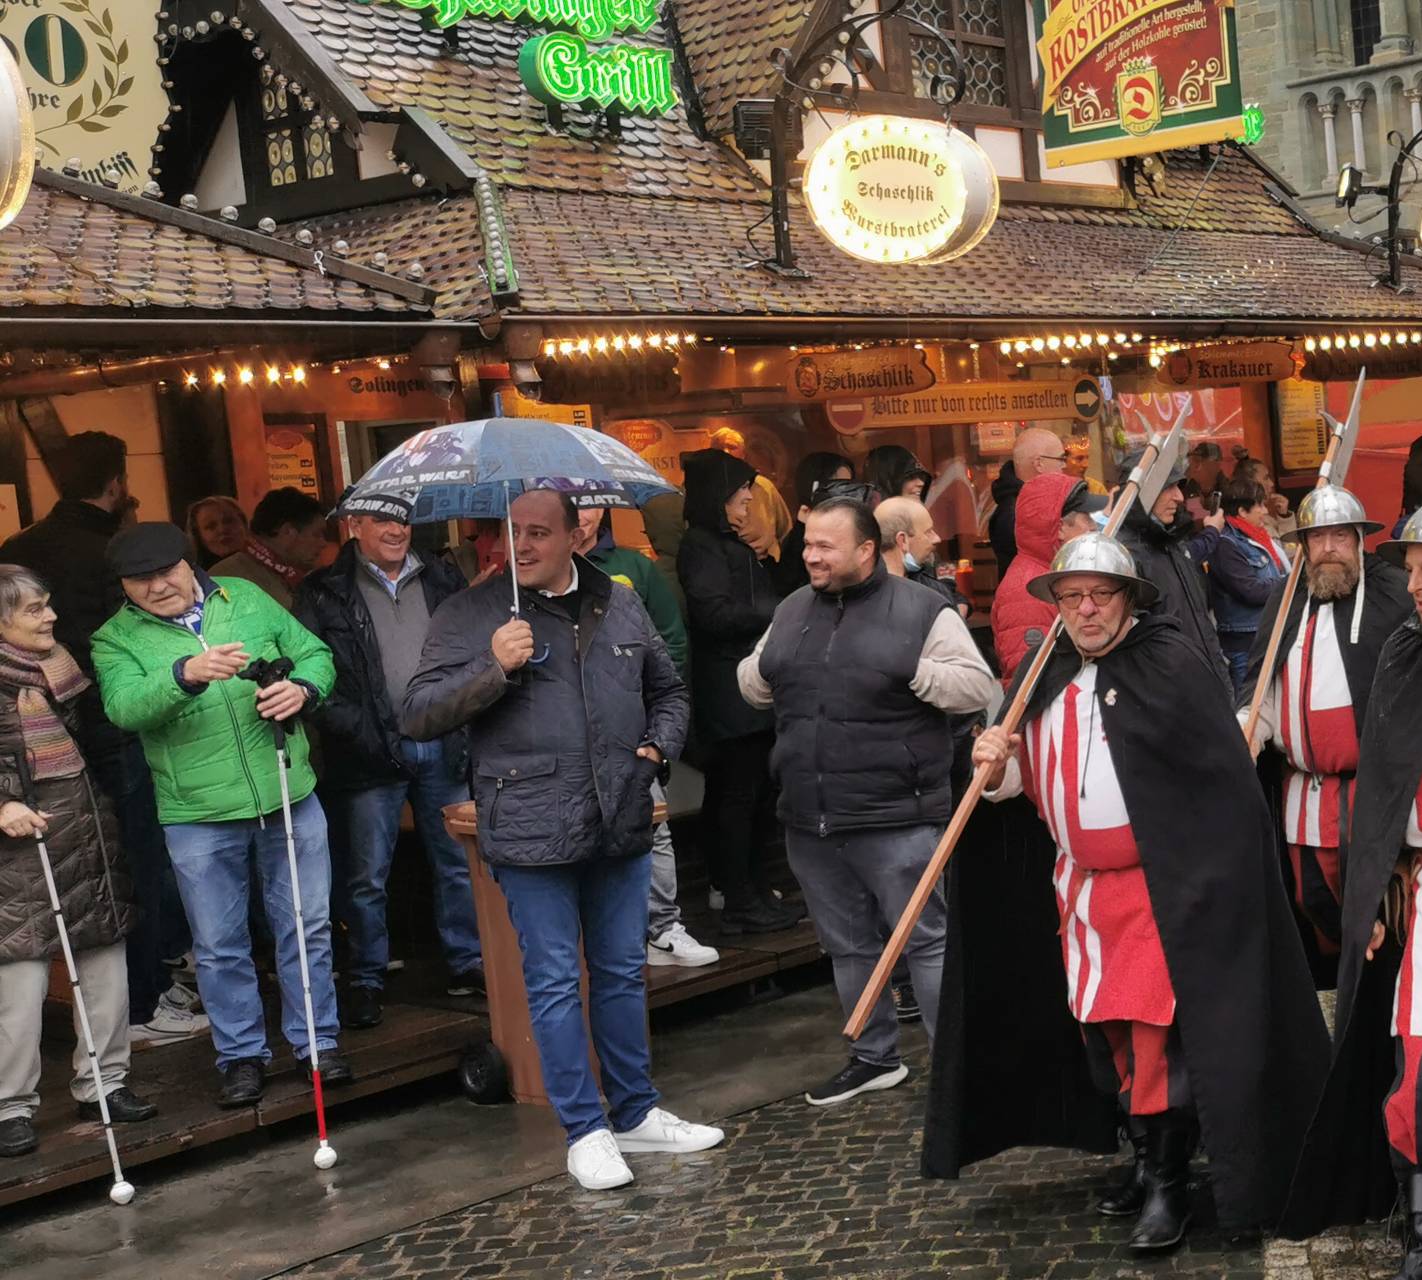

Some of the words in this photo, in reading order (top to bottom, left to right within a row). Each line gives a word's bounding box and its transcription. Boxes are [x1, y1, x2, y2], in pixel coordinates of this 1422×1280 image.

[1096, 44, 1107, 62] auf
[1107, 20, 1150, 53] traditionelle
[1151, 11, 1163, 25] Art
[1164, 1, 1206, 20] hergestellt,
[1104, 58, 1117, 72] auf
[1118, 46, 1130, 62] der
[1132, 24, 1171, 52] Holzkohle
[1173, 16, 1208, 38] geröstet!
[538, 31, 679, 114] Grill
[845, 144, 947, 177] Darmann's
[858, 181, 934, 203] Schaschlik
[841, 198, 951, 238] Wurstbraterei
[823, 364, 914, 392] Schaschlik
[1197, 360, 1273, 378] Krakauer
[873, 396, 909, 415] Bitte
[913, 398, 938, 414] nur
[940, 395, 965, 412] von
[968, 391, 1007, 413] rechts
[1011, 389, 1069, 409] anstellen
[364, 475, 417, 493] STAR
[418, 470, 471, 482] WARS
